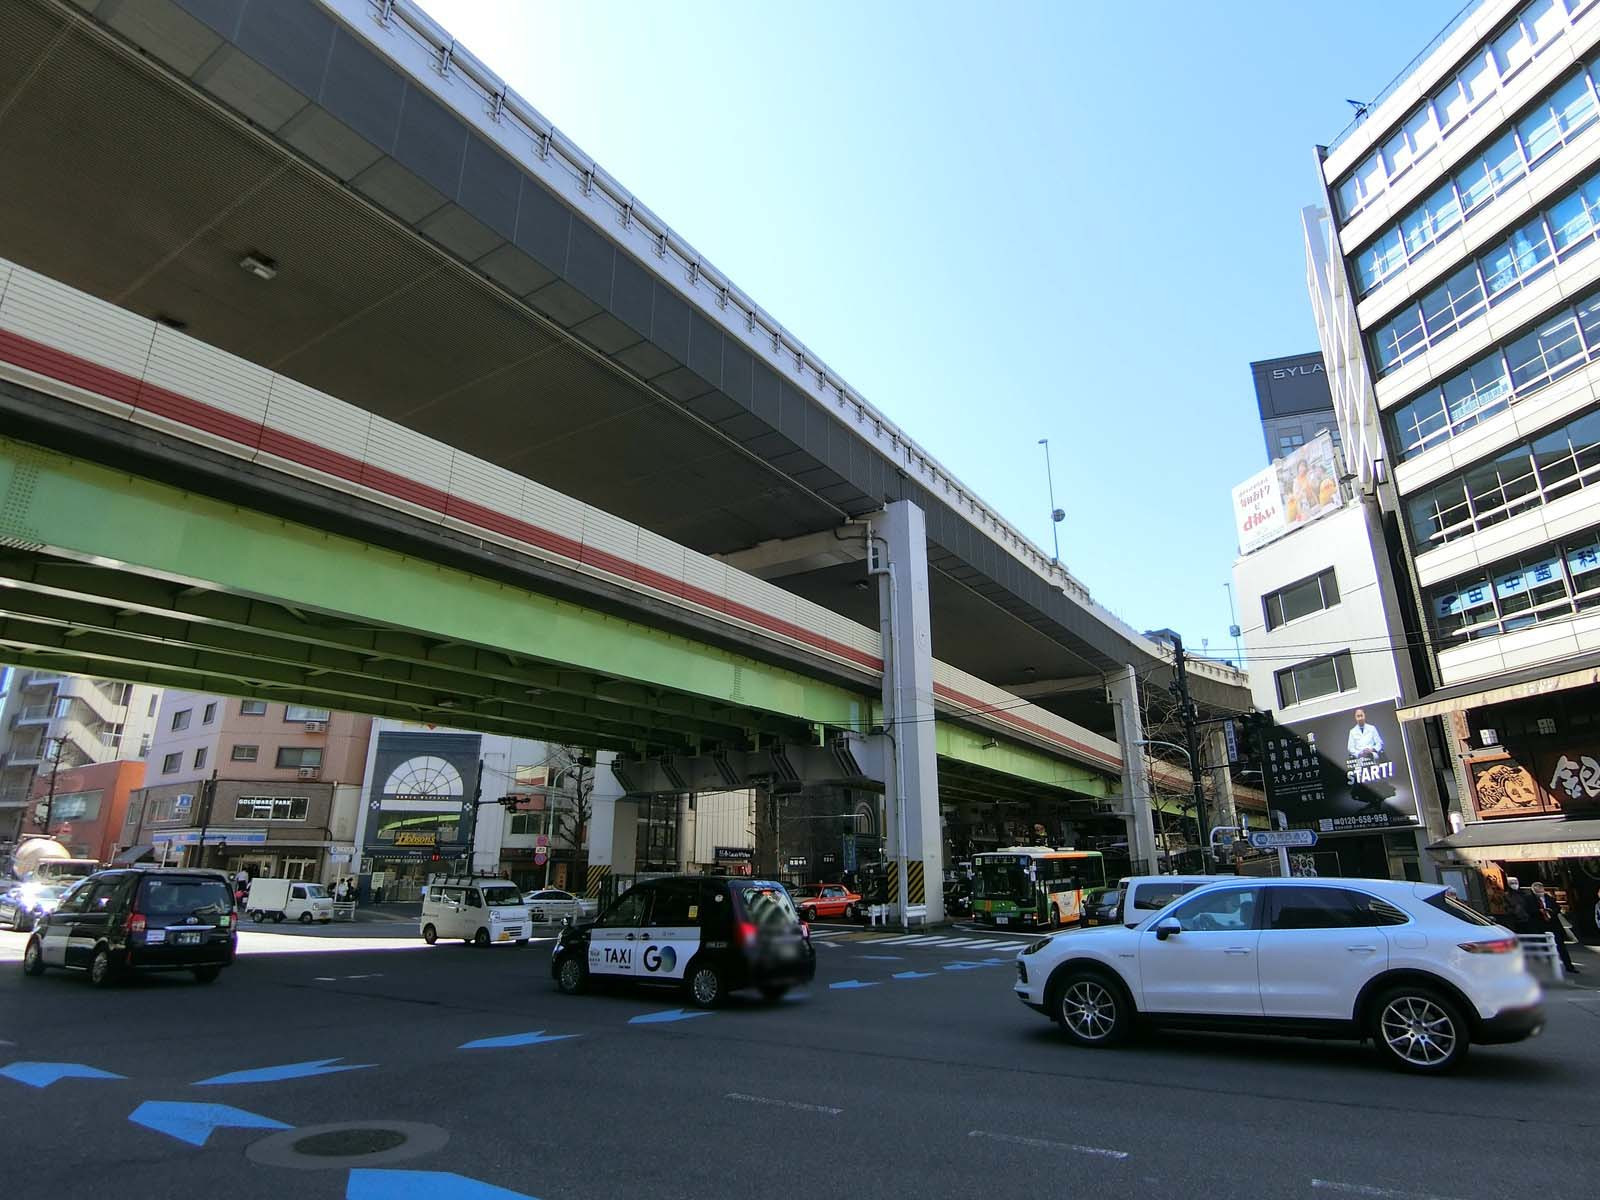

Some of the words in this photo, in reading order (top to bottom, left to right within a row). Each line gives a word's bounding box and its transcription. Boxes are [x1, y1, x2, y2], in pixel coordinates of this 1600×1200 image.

[1273, 363, 1325, 379] SYLA
[1347, 761, 1393, 785] START!
[604, 947, 632, 964] TAXI
[643, 945, 677, 973] GO
